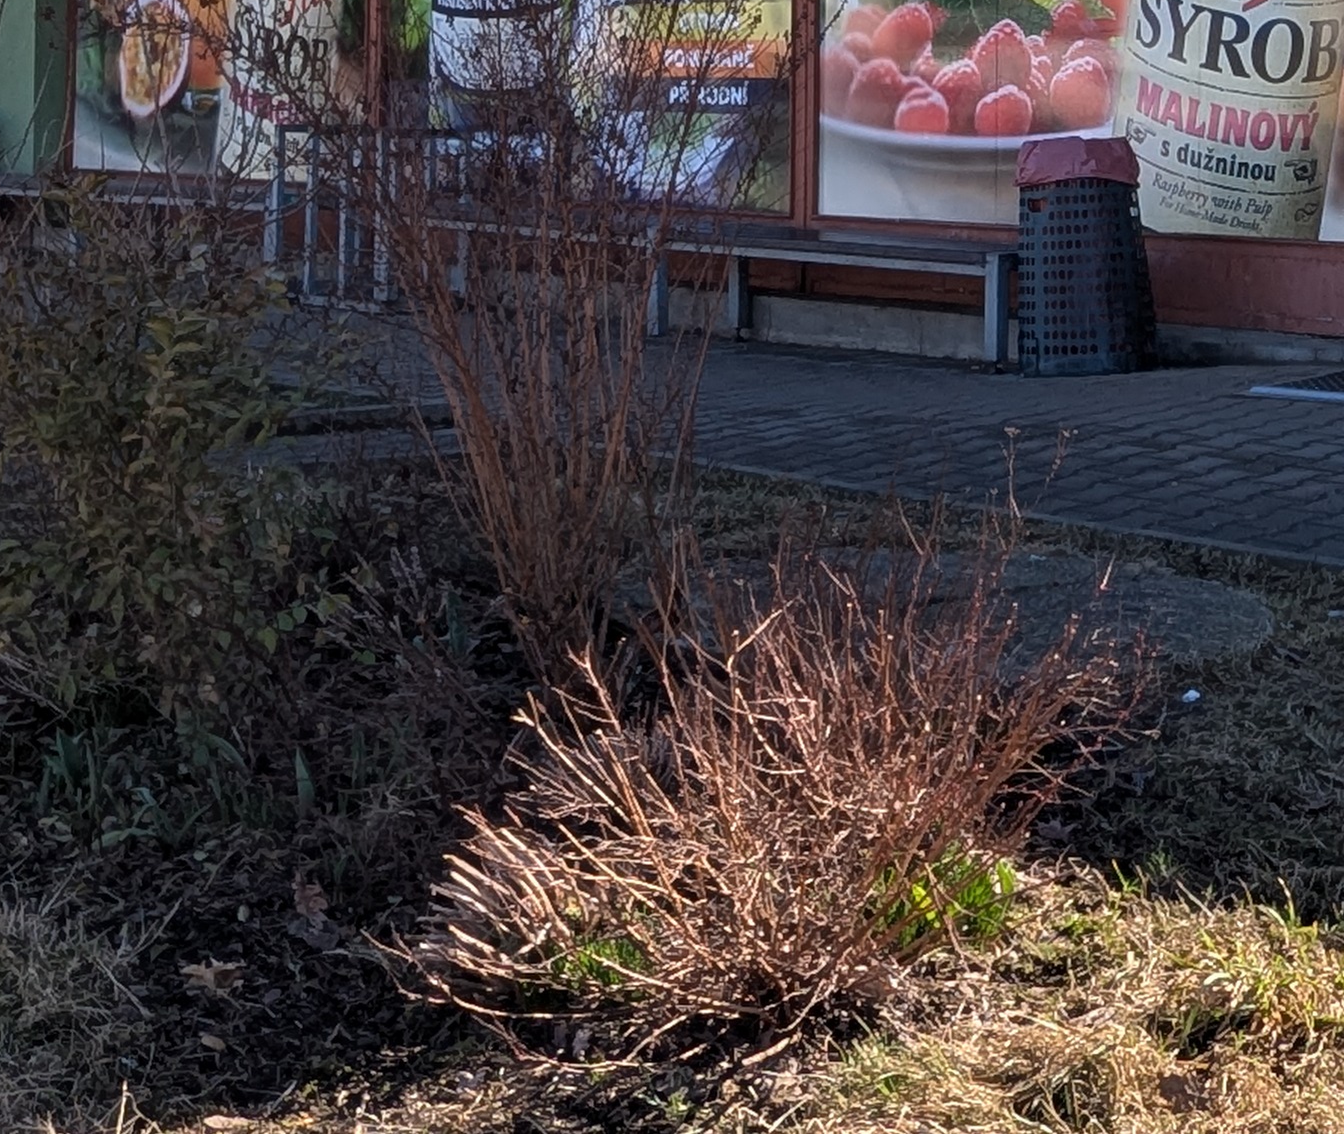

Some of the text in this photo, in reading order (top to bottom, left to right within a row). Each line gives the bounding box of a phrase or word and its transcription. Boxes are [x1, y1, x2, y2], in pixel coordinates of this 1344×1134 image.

[668, 79, 750, 106] PŘRODNÍ
[1136, 74, 1320, 153] MALINOVÝ
[1159, 139, 1277, 182] s dužninou
[1152, 172, 1274, 221] Raspberry with Pulp
